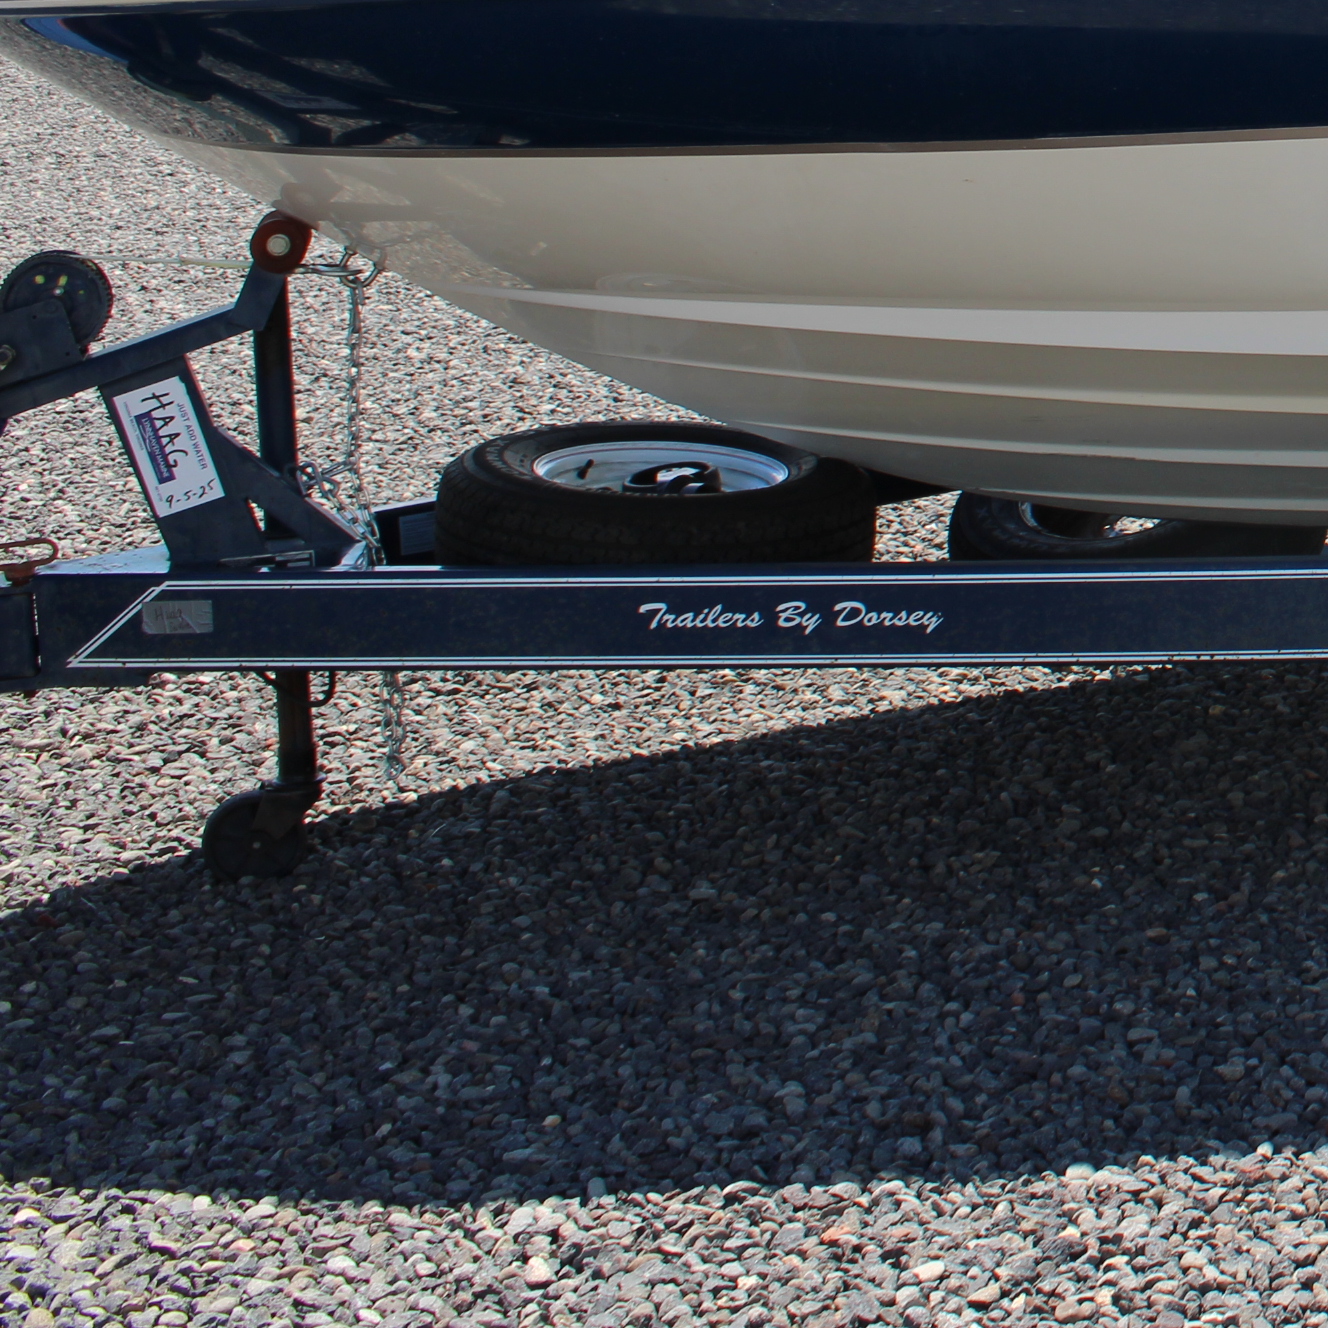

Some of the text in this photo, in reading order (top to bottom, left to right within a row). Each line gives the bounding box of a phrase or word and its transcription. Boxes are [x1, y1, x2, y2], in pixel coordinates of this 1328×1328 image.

[141, 392, 189, 468] HAAG
[177, 402, 208, 470] JUST ADD WATER
[166, 478, 216, 508] 9-5-25
[638, 601, 944, 635] Trailers By Dorsey
